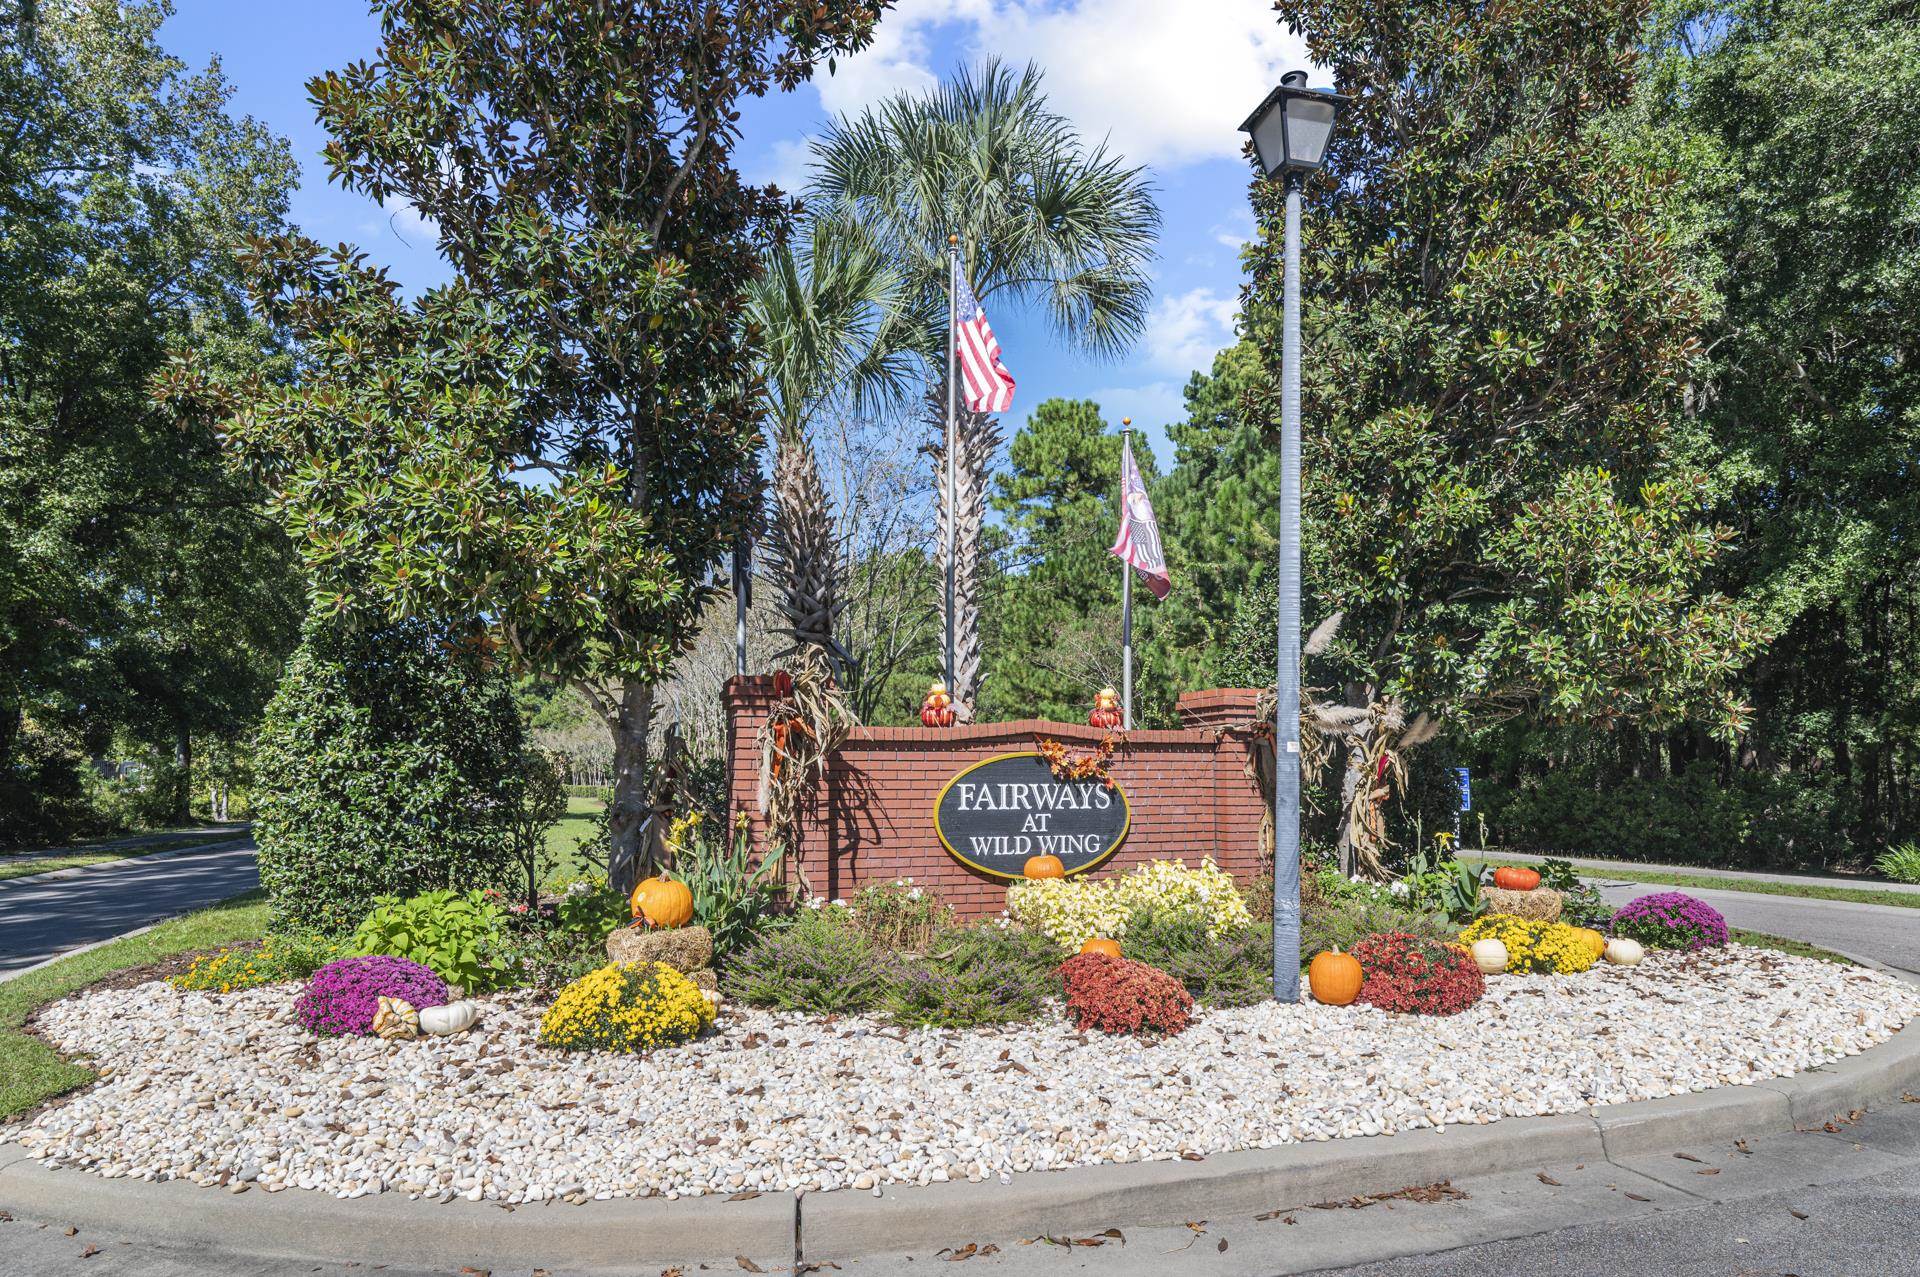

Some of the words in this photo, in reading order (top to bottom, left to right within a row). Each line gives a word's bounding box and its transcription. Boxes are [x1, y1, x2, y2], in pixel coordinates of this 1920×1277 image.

[957, 783, 1111, 811] FAIRWAYS
[1020, 813, 1052, 832] AT
[969, 836, 1031, 856] WILD
[1036, 834, 1101, 855] WING
